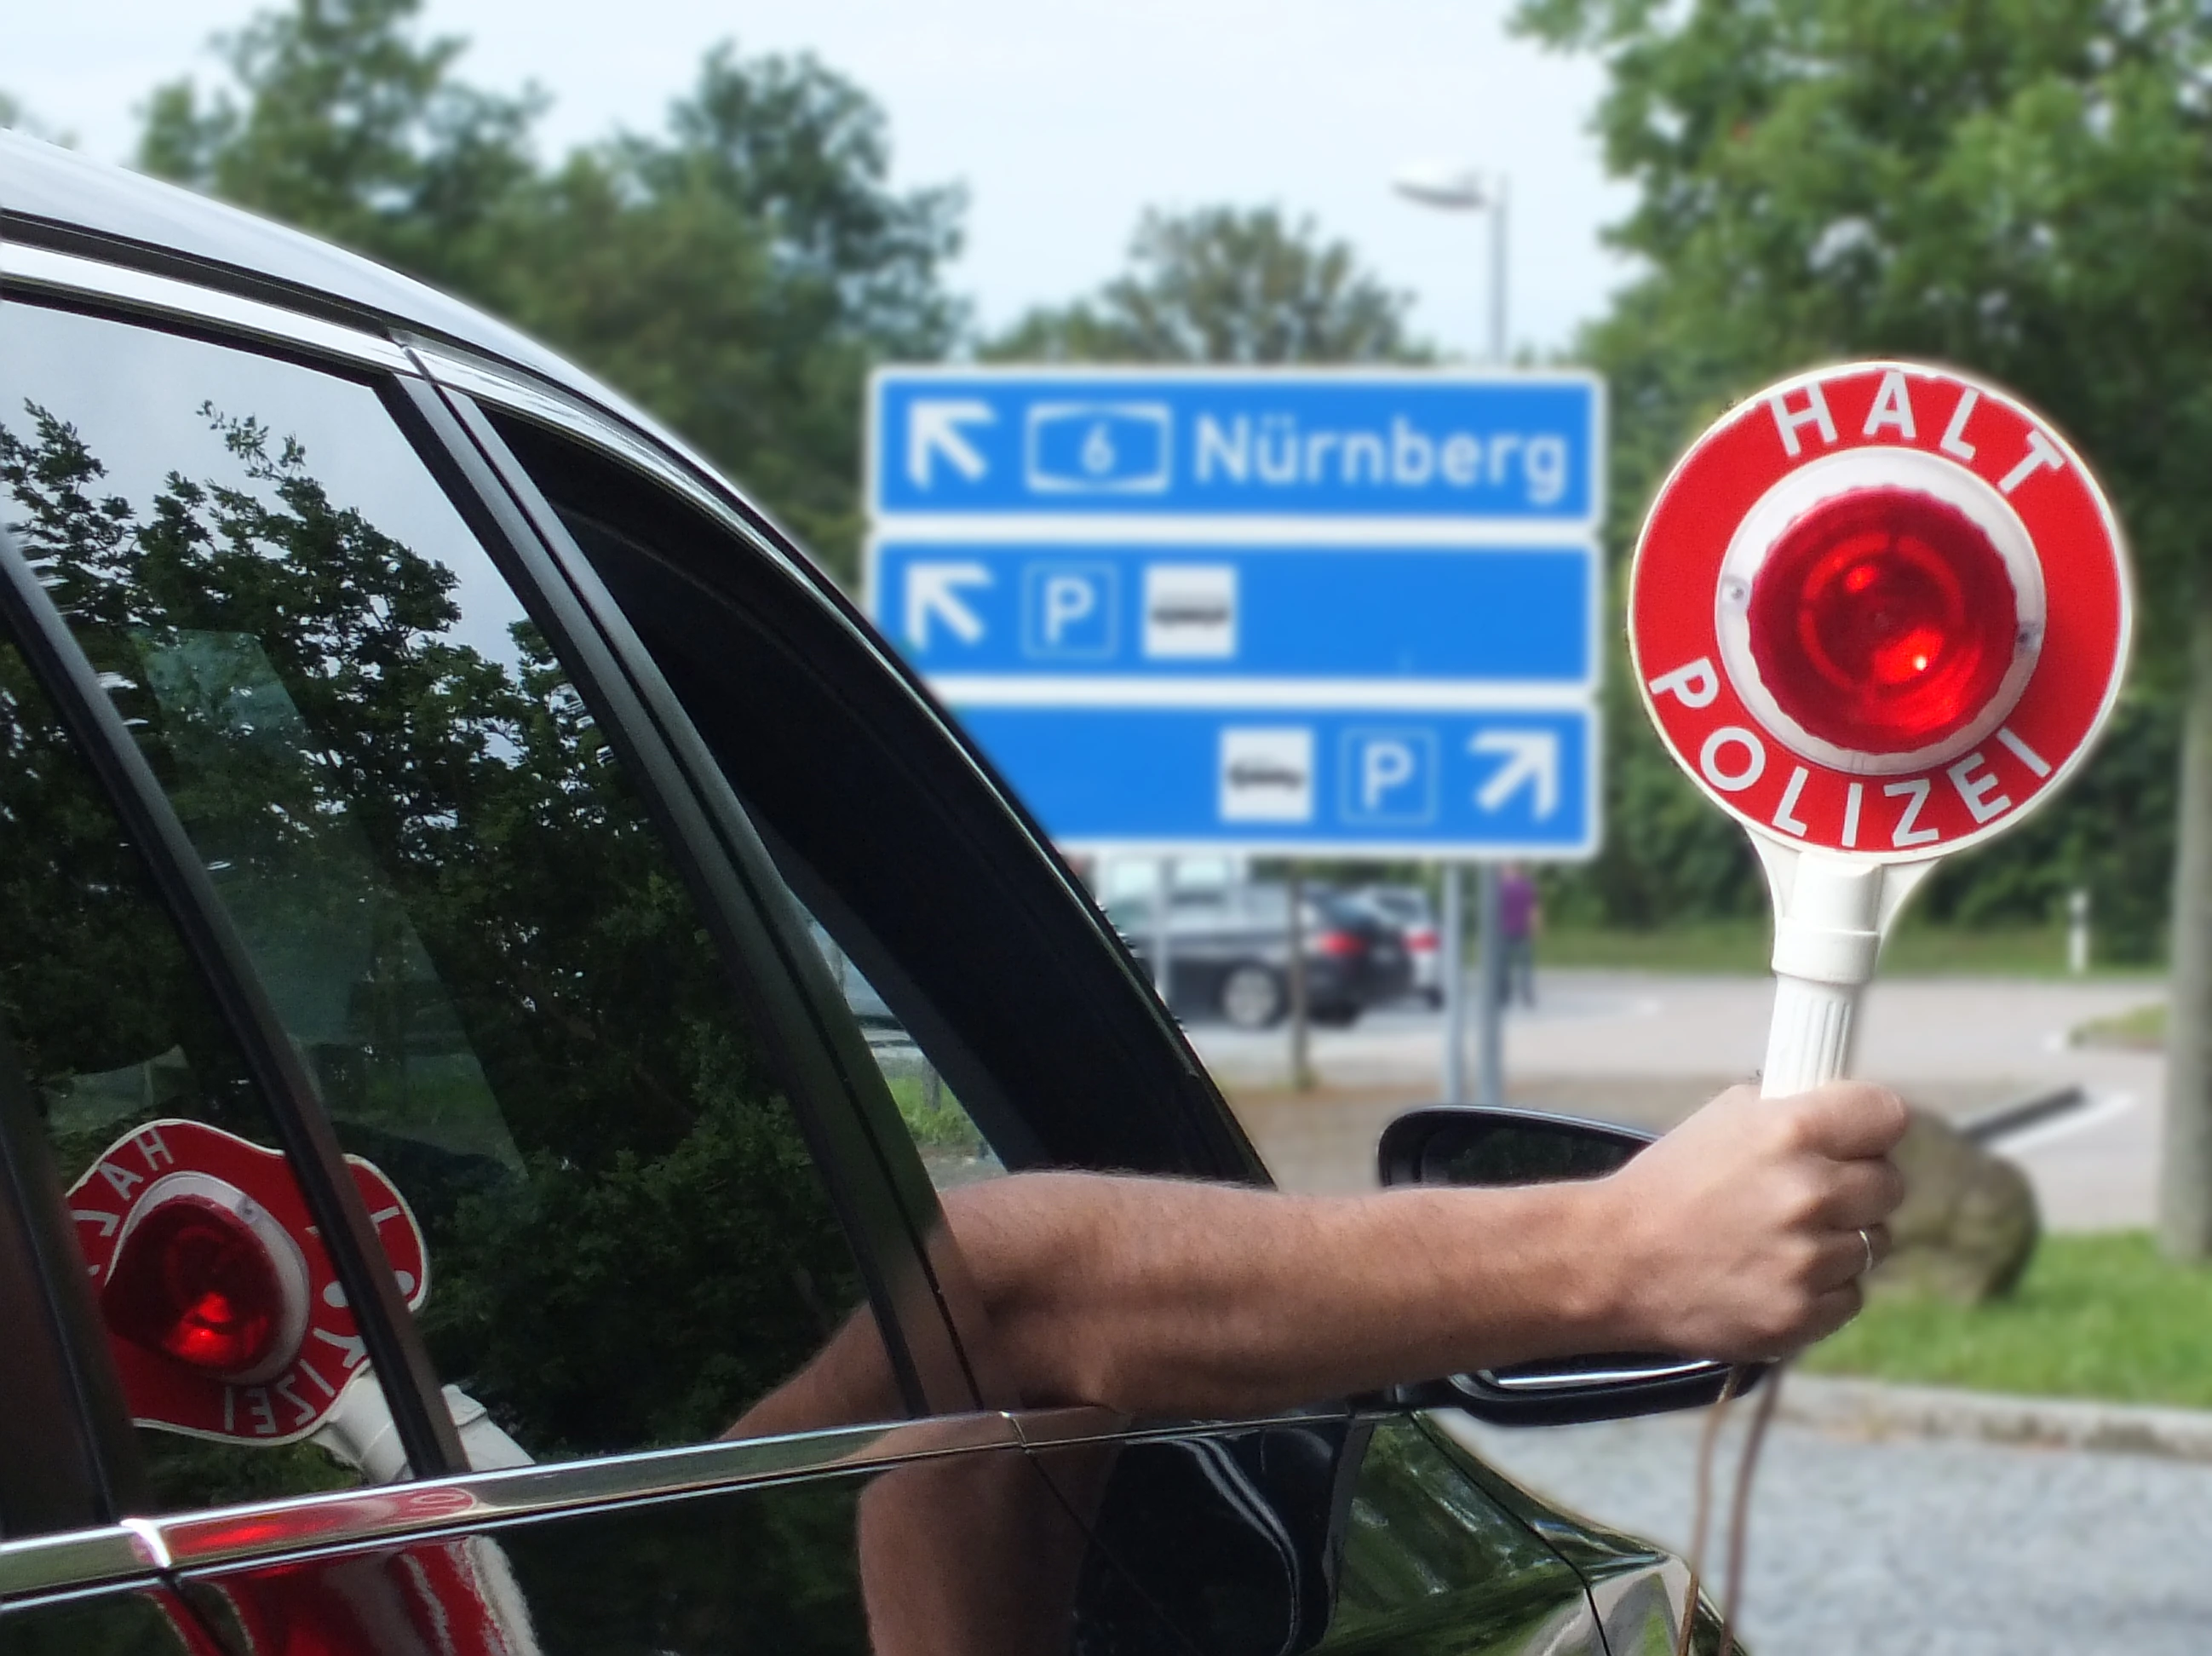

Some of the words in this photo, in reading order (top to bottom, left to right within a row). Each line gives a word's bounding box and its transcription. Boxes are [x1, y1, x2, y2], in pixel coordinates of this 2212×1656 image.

[1081, 423, 1116, 474] 6
[1194, 412, 1568, 504] Nürnberg
[1769, 370, 2065, 494] HALT
[1045, 575, 1096, 646] P
[1363, 741, 1415, 812] P
[1649, 656, 2052, 848] POLIZEI
